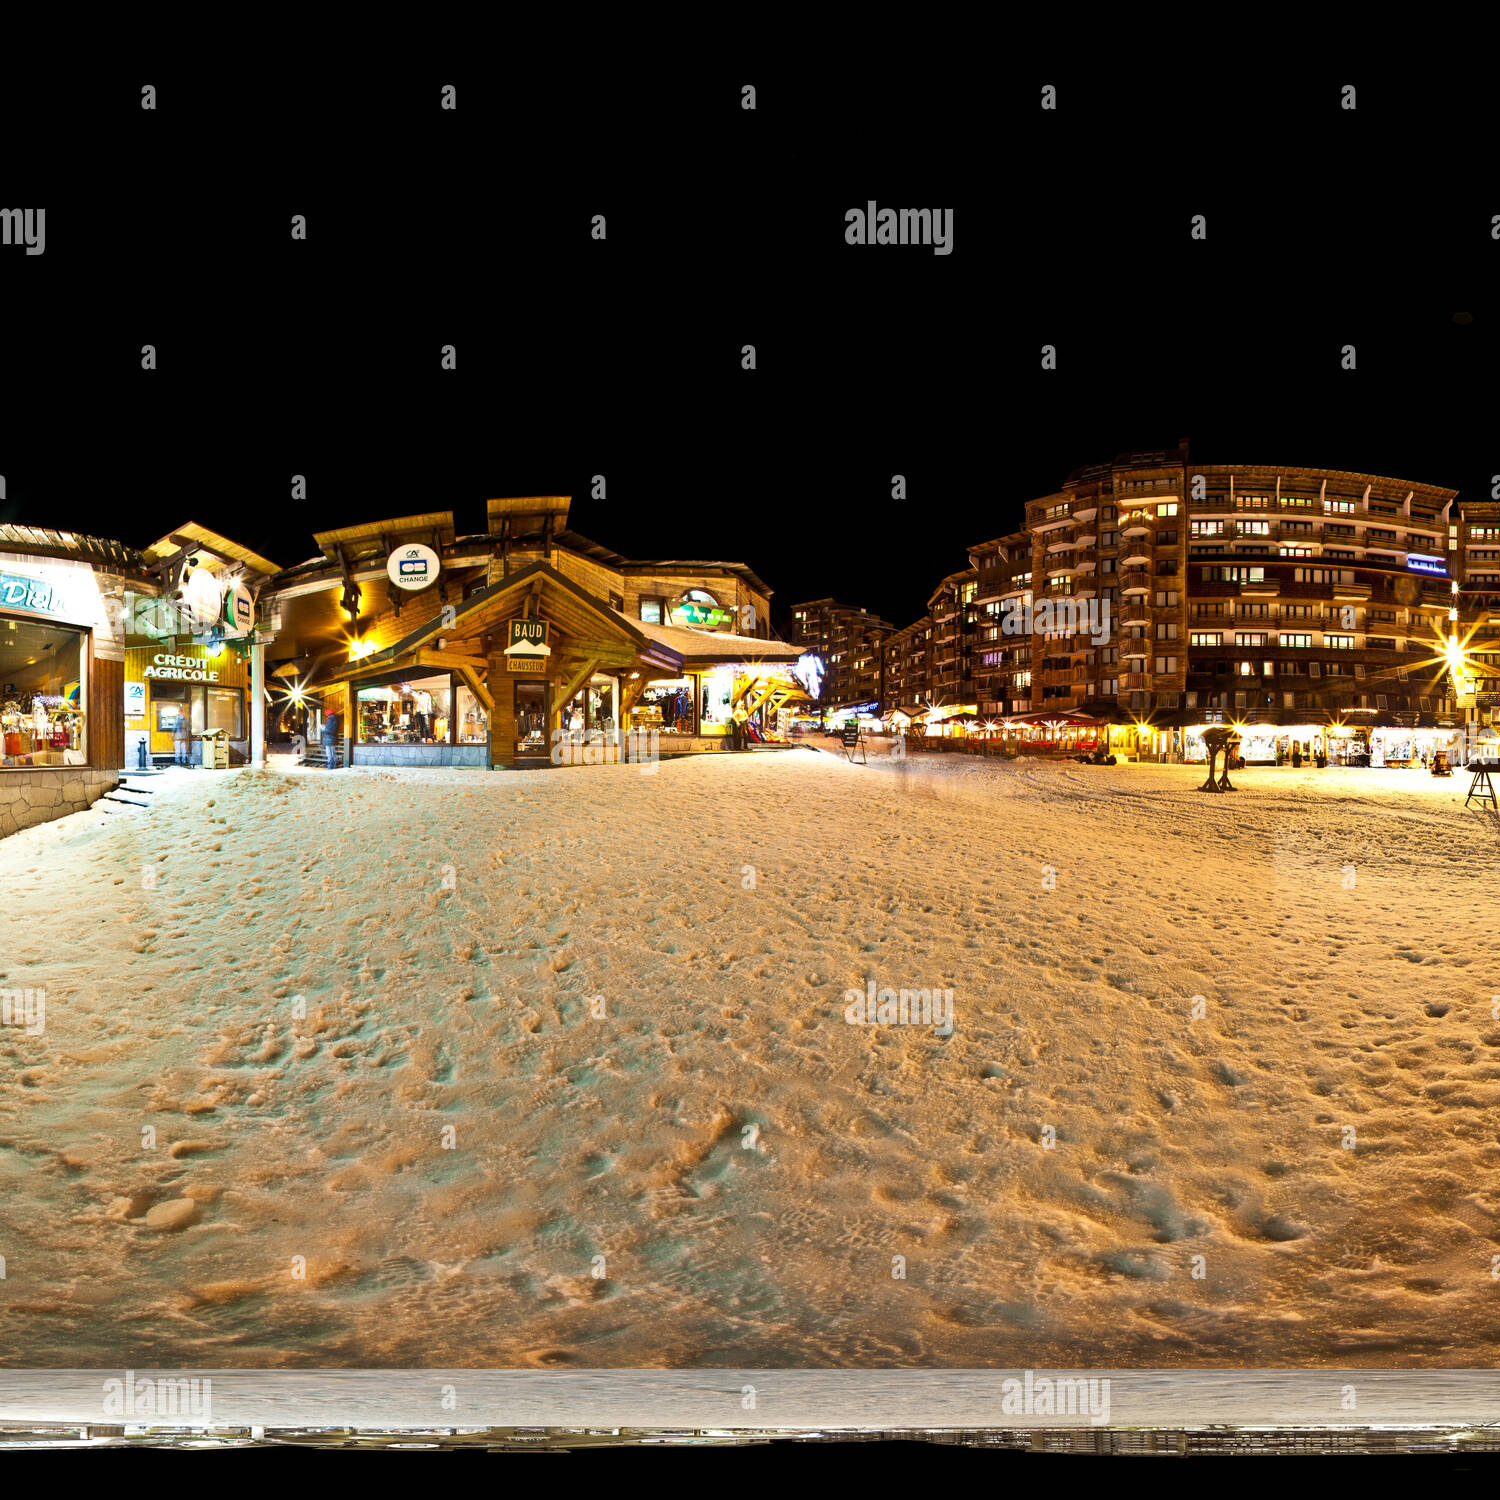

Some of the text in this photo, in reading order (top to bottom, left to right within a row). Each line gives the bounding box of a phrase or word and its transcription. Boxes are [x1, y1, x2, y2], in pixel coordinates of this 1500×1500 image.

[399, 575, 429, 583] CHANGE
[514, 623, 543, 638] BAUD
[153, 653, 209, 669] CRÉDIT
[509, 660, 545, 671] CHAUSSEUR
[143, 665, 220, 682] AGRICOLE
